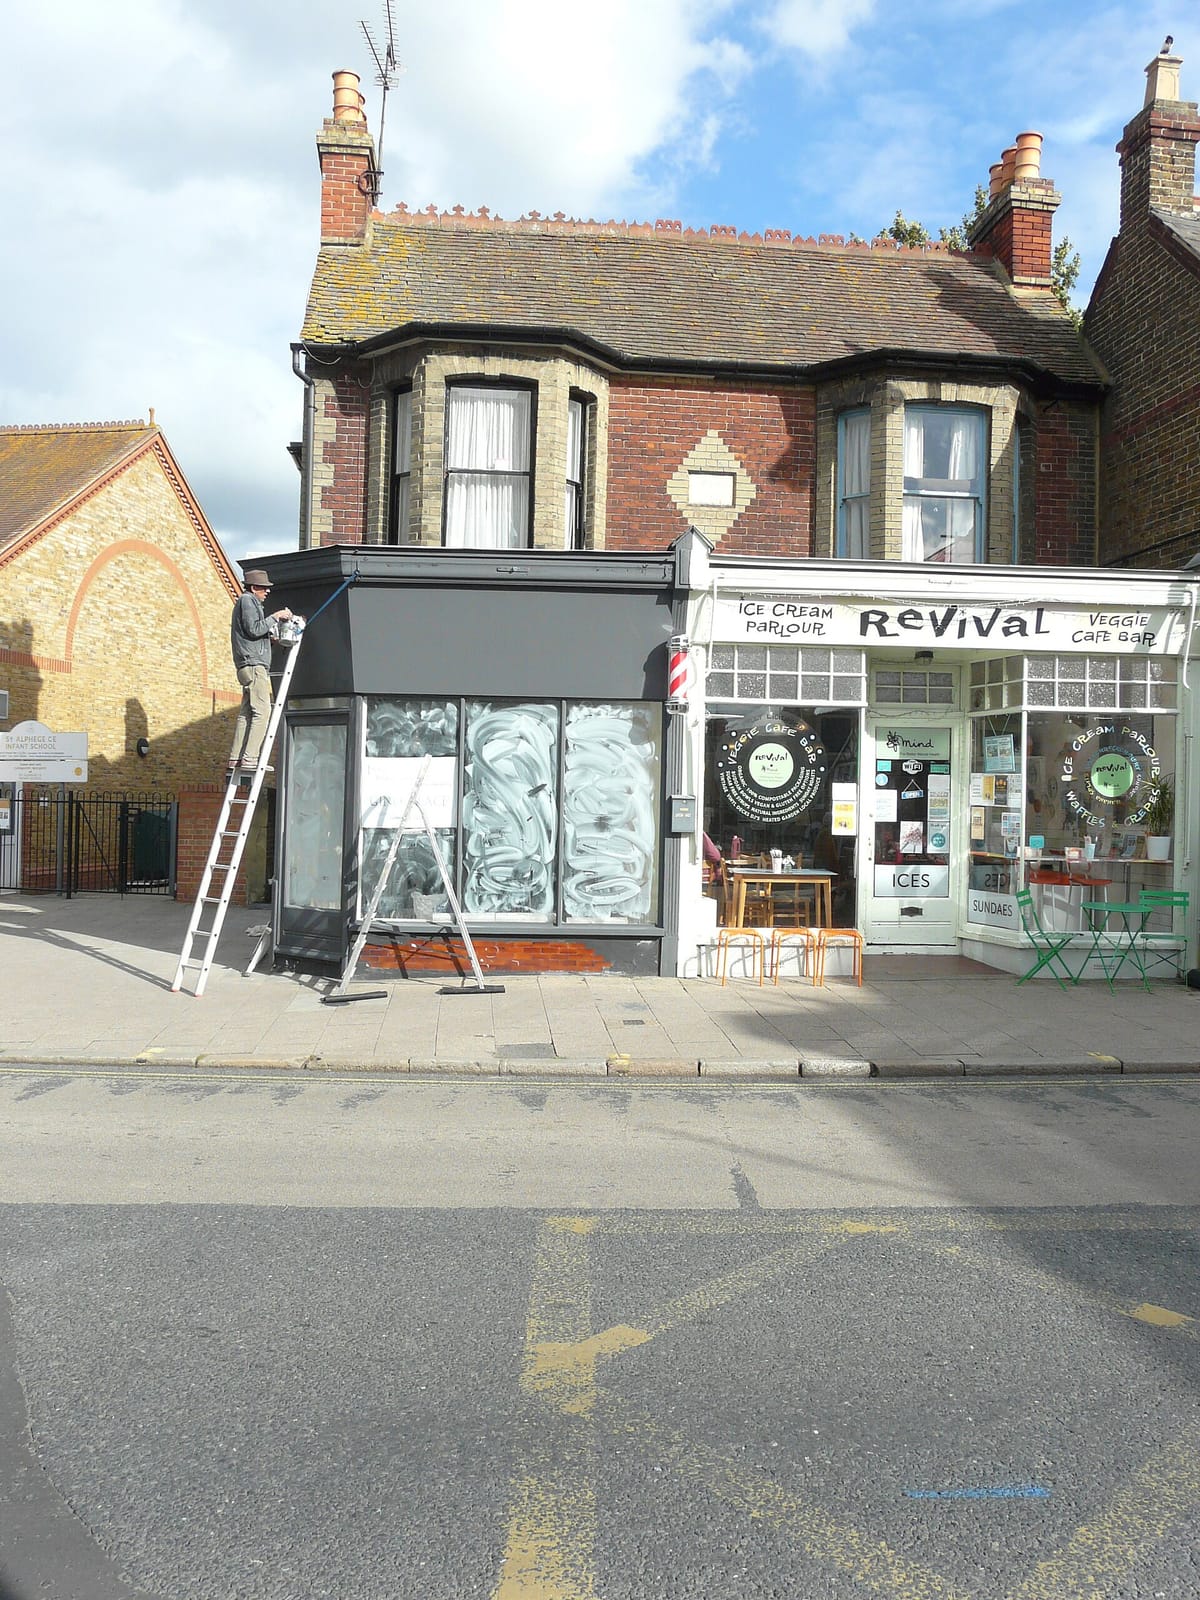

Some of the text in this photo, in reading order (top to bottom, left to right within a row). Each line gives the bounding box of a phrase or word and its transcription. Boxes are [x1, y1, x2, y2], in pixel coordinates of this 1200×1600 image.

[738, 765, 748, 788] ORGANIC
[754, 800, 770, 808] VEGAN
[776, 797, 793, 808] GLUTEN
[793, 789, 803, 799] FREE
[801, 769, 811, 790] OPTIONS
[720, 772, 729, 793] VINTAGE
[736, 805, 750, 817] DECKS
[781, 810, 799, 821] GARDEN
[799, 799, 812, 811] LOCAL
[810, 777, 821, 799] PRODUCE
[725, 770, 733, 786] SUGAR
[729, 785, 738, 797] FREE
[751, 807, 771, 816] NATURAL
[893, 873, 930, 888] ICES
[973, 899, 1013, 917] SUNDAES
